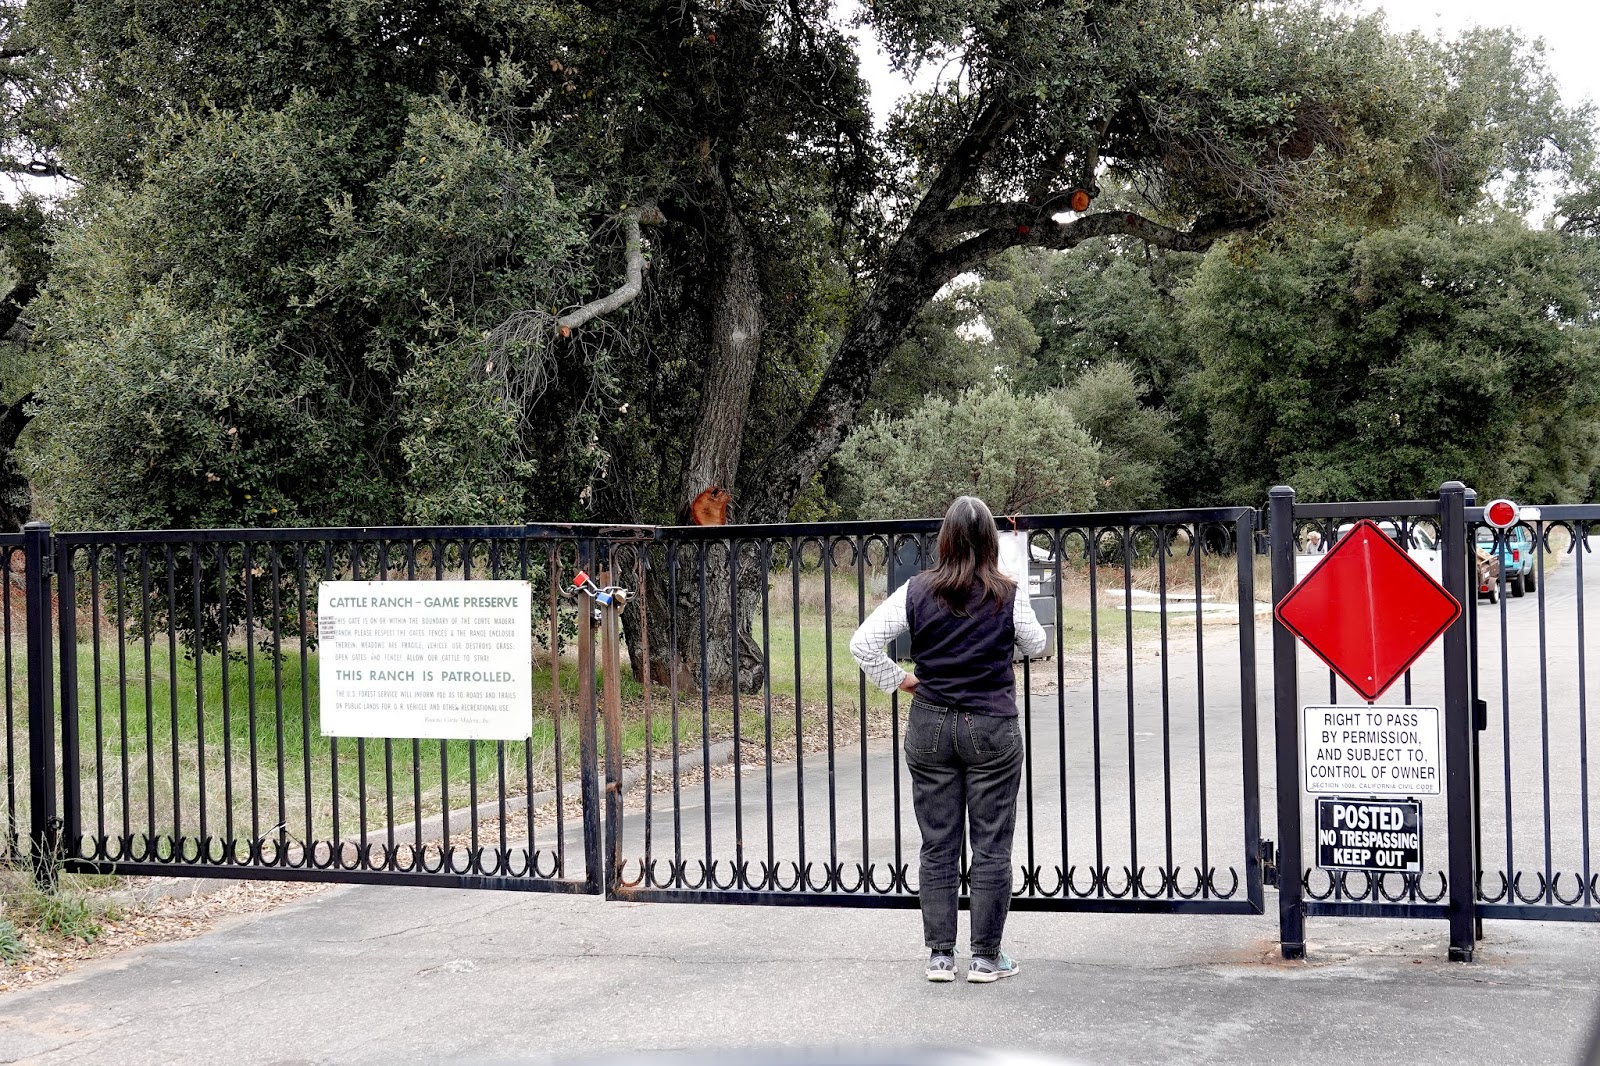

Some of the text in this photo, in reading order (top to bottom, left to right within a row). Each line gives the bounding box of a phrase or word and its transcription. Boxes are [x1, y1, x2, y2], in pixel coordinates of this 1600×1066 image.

[329, 597, 368, 608] CATTLE
[371, 597, 412, 608] RANCH
[424, 597, 460, 608] GAME
[464, 597, 518, 608] PRESERVE
[336, 670, 515, 682] THIS RANCH IS PATROLLED.
[1324, 714, 1418, 726] RIGHT TO PASS
[1322, 731, 1421, 745] BY PERMISSION,
[1317, 749, 1428, 763] AND SUBJECT TO,
[1311, 766, 1435, 779] CONTROL OF OWNER
[1333, 805, 1404, 830] POSTED
[1320, 830, 1418, 849] NO TRESPASSING
[1333, 848, 1404, 866] KEEP OUT
